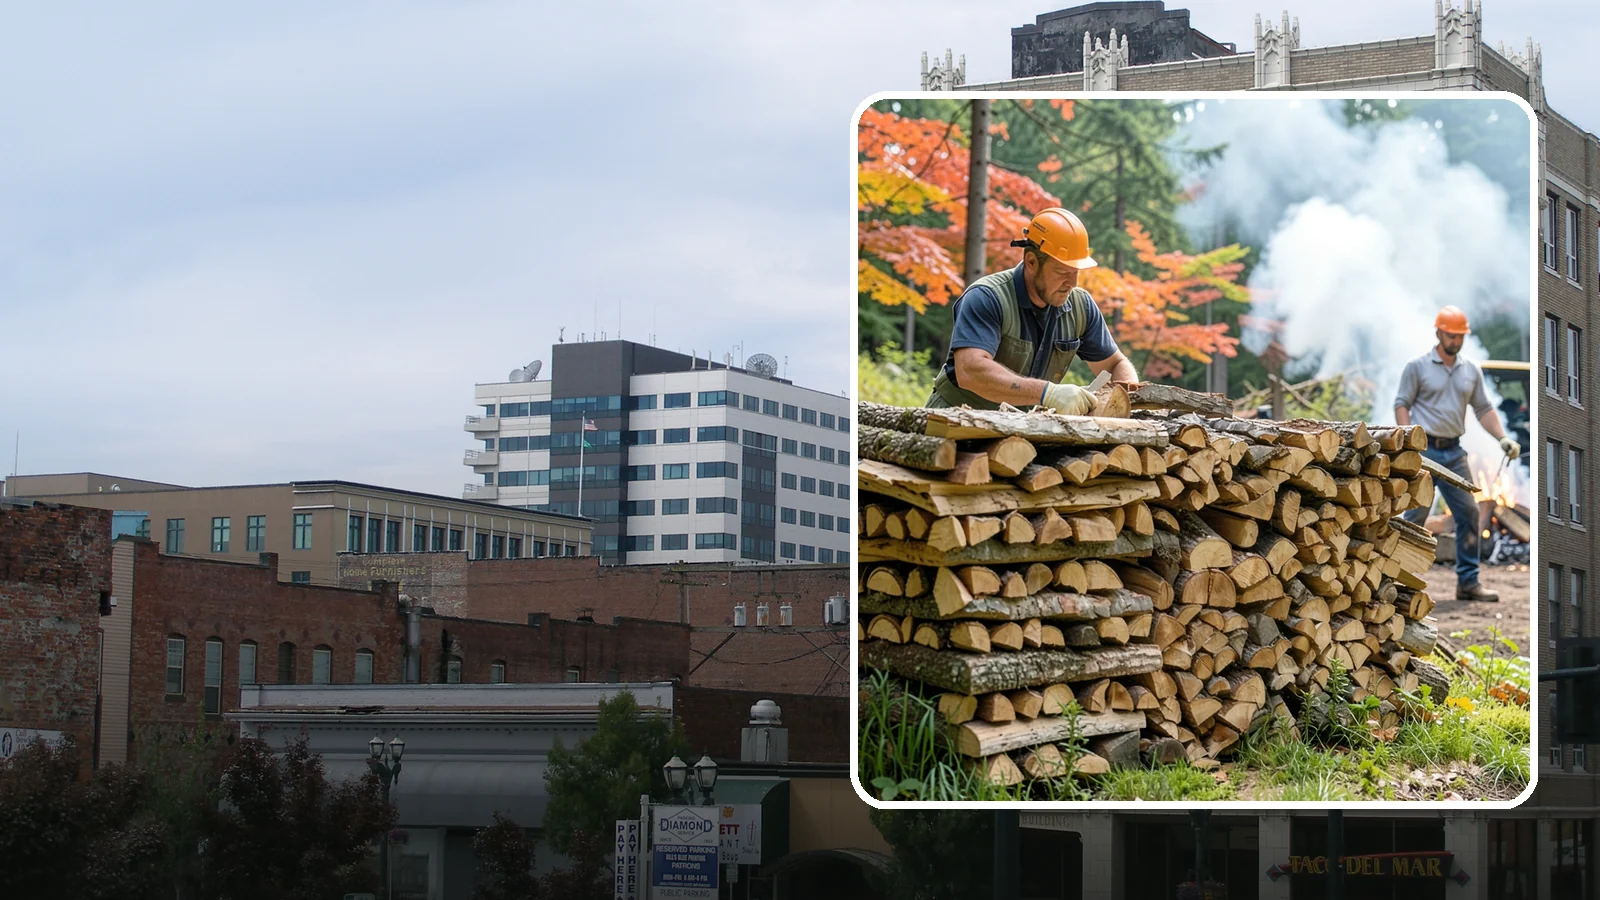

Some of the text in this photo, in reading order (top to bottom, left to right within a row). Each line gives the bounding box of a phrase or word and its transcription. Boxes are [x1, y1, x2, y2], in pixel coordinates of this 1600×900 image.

[370, 566, 427, 576] Furnishers
[660, 818, 713, 833] DIAMOND
[1022, 815, 1070, 828] BUILDING
[656, 845, 716, 854] RESERVED PARKING
[617, 825, 625, 893] PAY HERE
[628, 824, 637, 893] PAY HERE
[721, 851, 739, 862] Soup
[671, 862, 701, 870] PATRONS
[1289, 855, 1442, 877] TAC DEL MAR
[660, 888, 710, 898] PUBLIC PARKING
